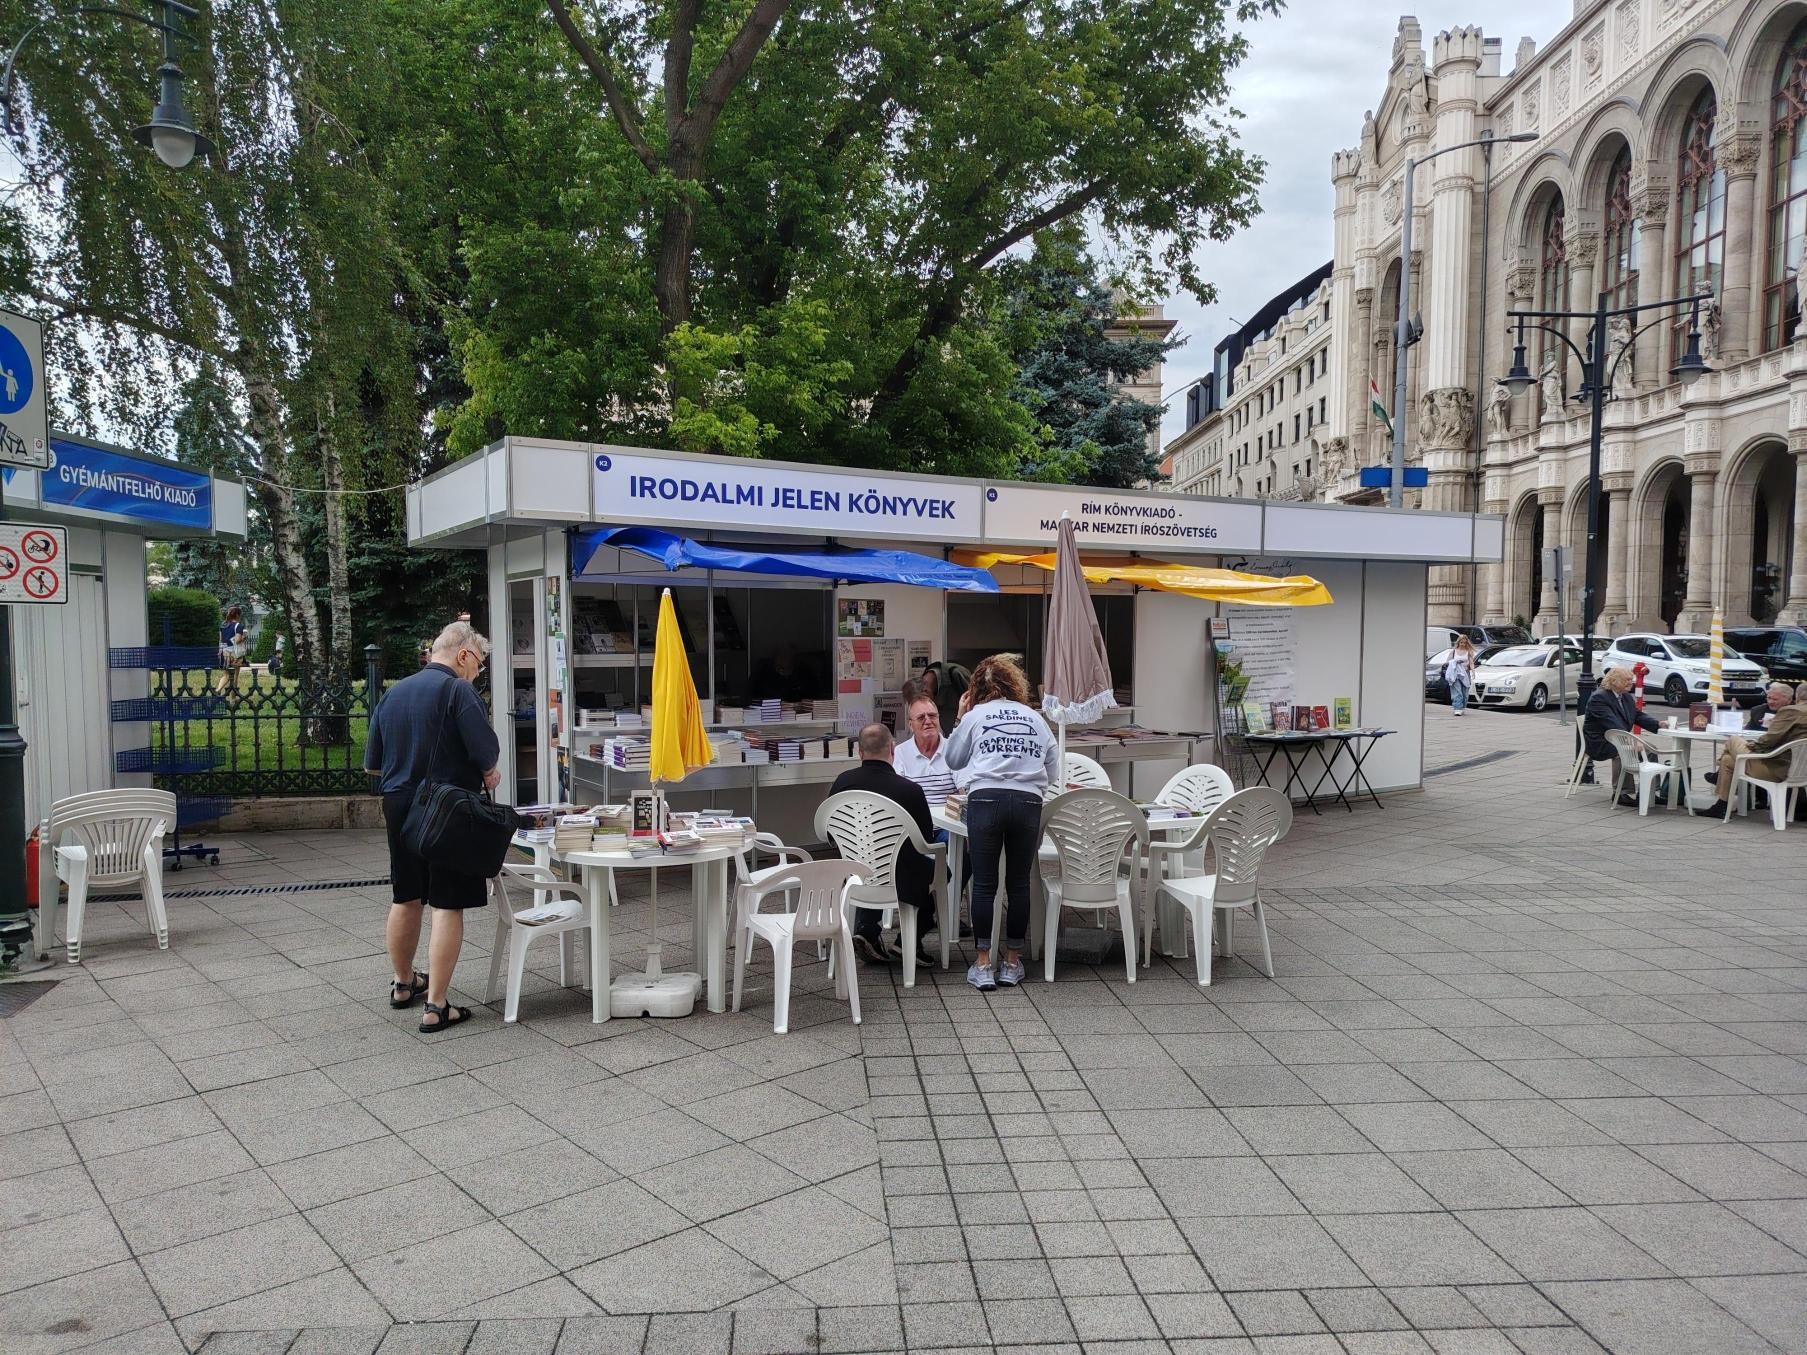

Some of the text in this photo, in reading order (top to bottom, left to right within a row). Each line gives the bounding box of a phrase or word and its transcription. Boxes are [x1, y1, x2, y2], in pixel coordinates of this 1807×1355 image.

[60, 464, 197, 507] GYÉMÁNTFELHŐ KIADÓ
[630, 475, 956, 519] IRODALMI JELEN KÖNYVEK
[1081, 500, 1101, 515] RÍM
[1104, 503, 1176, 519] KÖNYVKIADÓ
[1040, 519, 1217, 538] MAAR NEMZETI ÍRÓSZÖVETSÉG
[986, 714, 1034, 723] SARDINES
[979, 737, 1043, 752] CRAFTING THE
[982, 744, 1041, 758] CURRENTS
